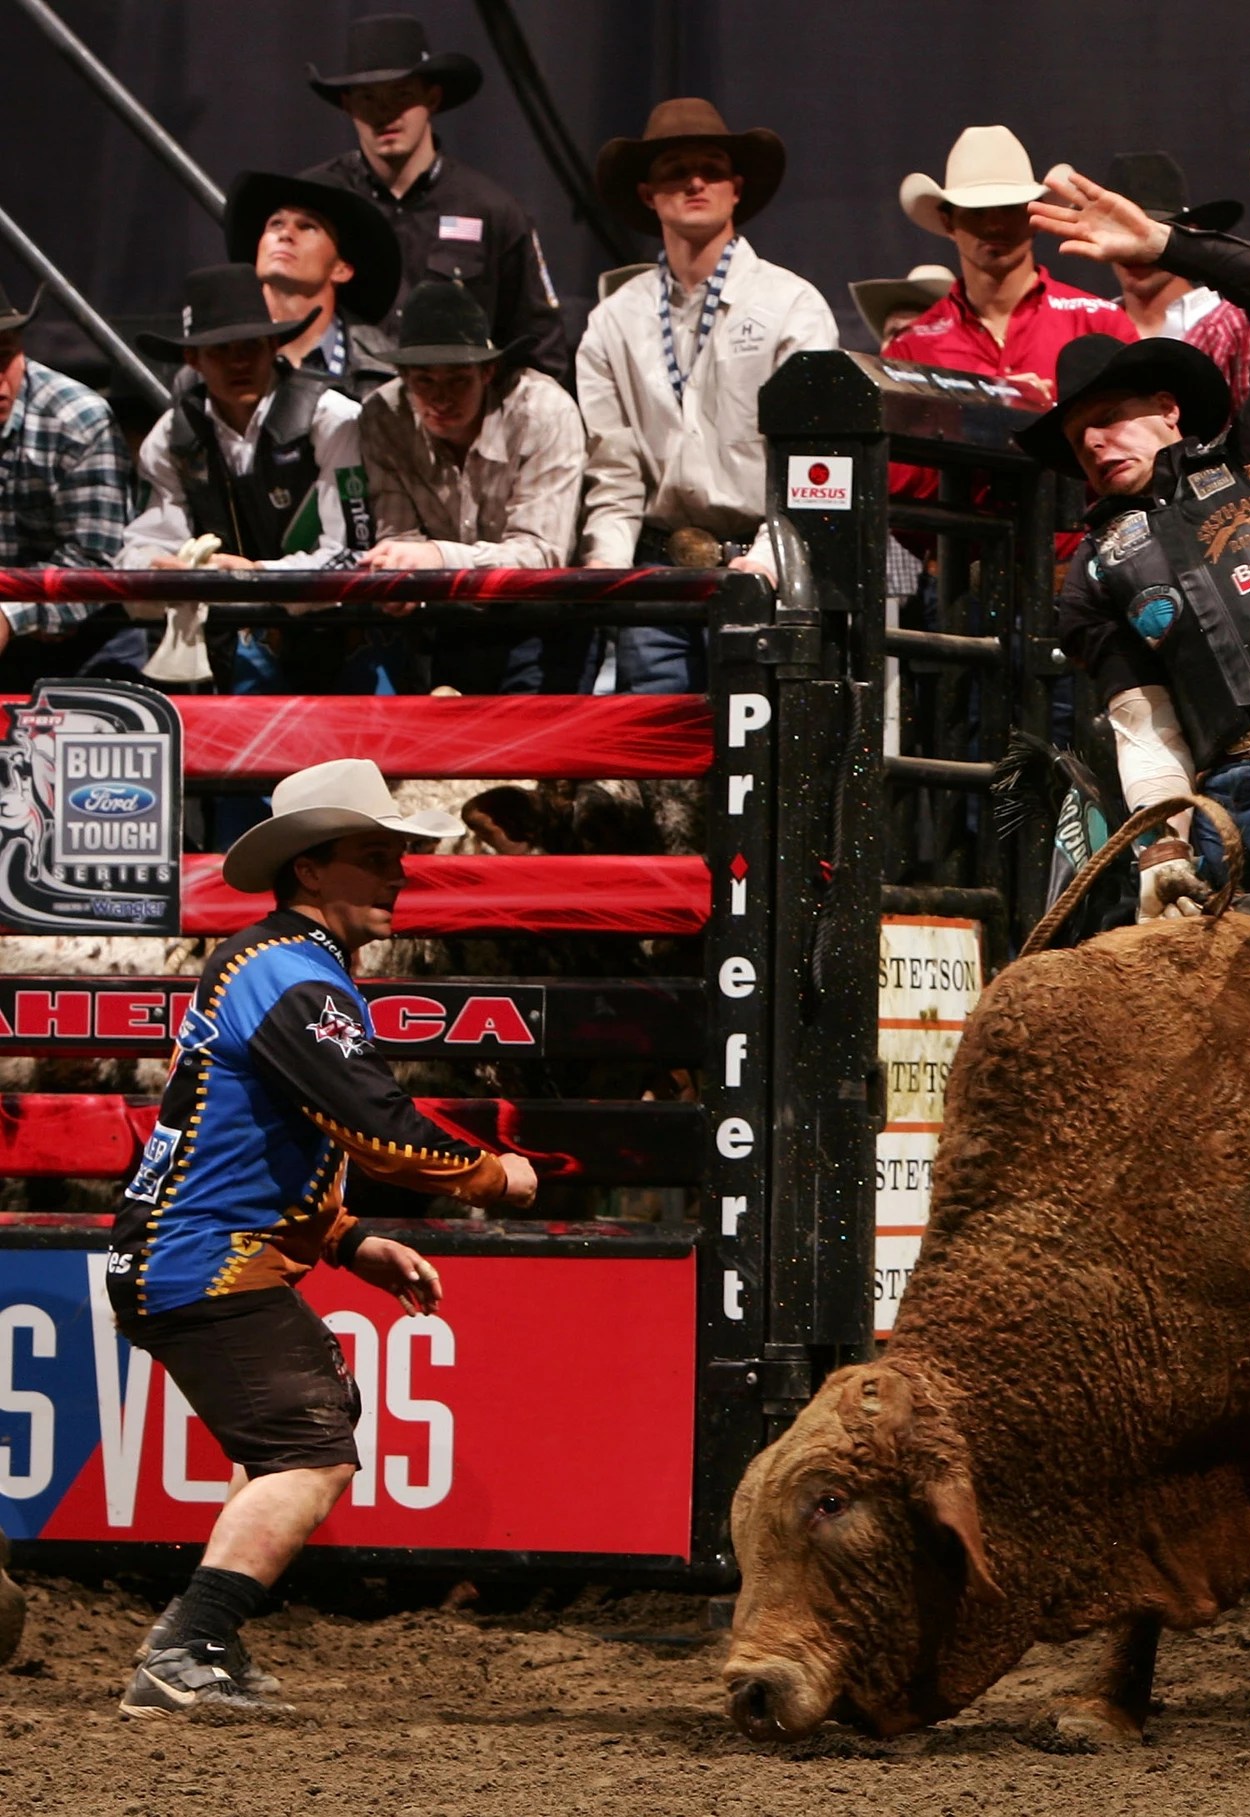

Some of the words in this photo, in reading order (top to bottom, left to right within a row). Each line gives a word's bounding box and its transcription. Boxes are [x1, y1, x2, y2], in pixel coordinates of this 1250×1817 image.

[791, 487, 847, 499] VERSUS
[67, 747, 157, 779] BUILT
[84, 787, 139, 813] Ford
[67, 821, 157, 850] TOUGH
[53, 864, 170, 882] SERIES
[91, 897, 166, 923] Wrangler
[879, 957, 976, 992] STETSON
[716, 693, 772, 1320] Priefert
[890, 1061, 950, 1093] TETS
[876, 1159, 935, 1191] STET
